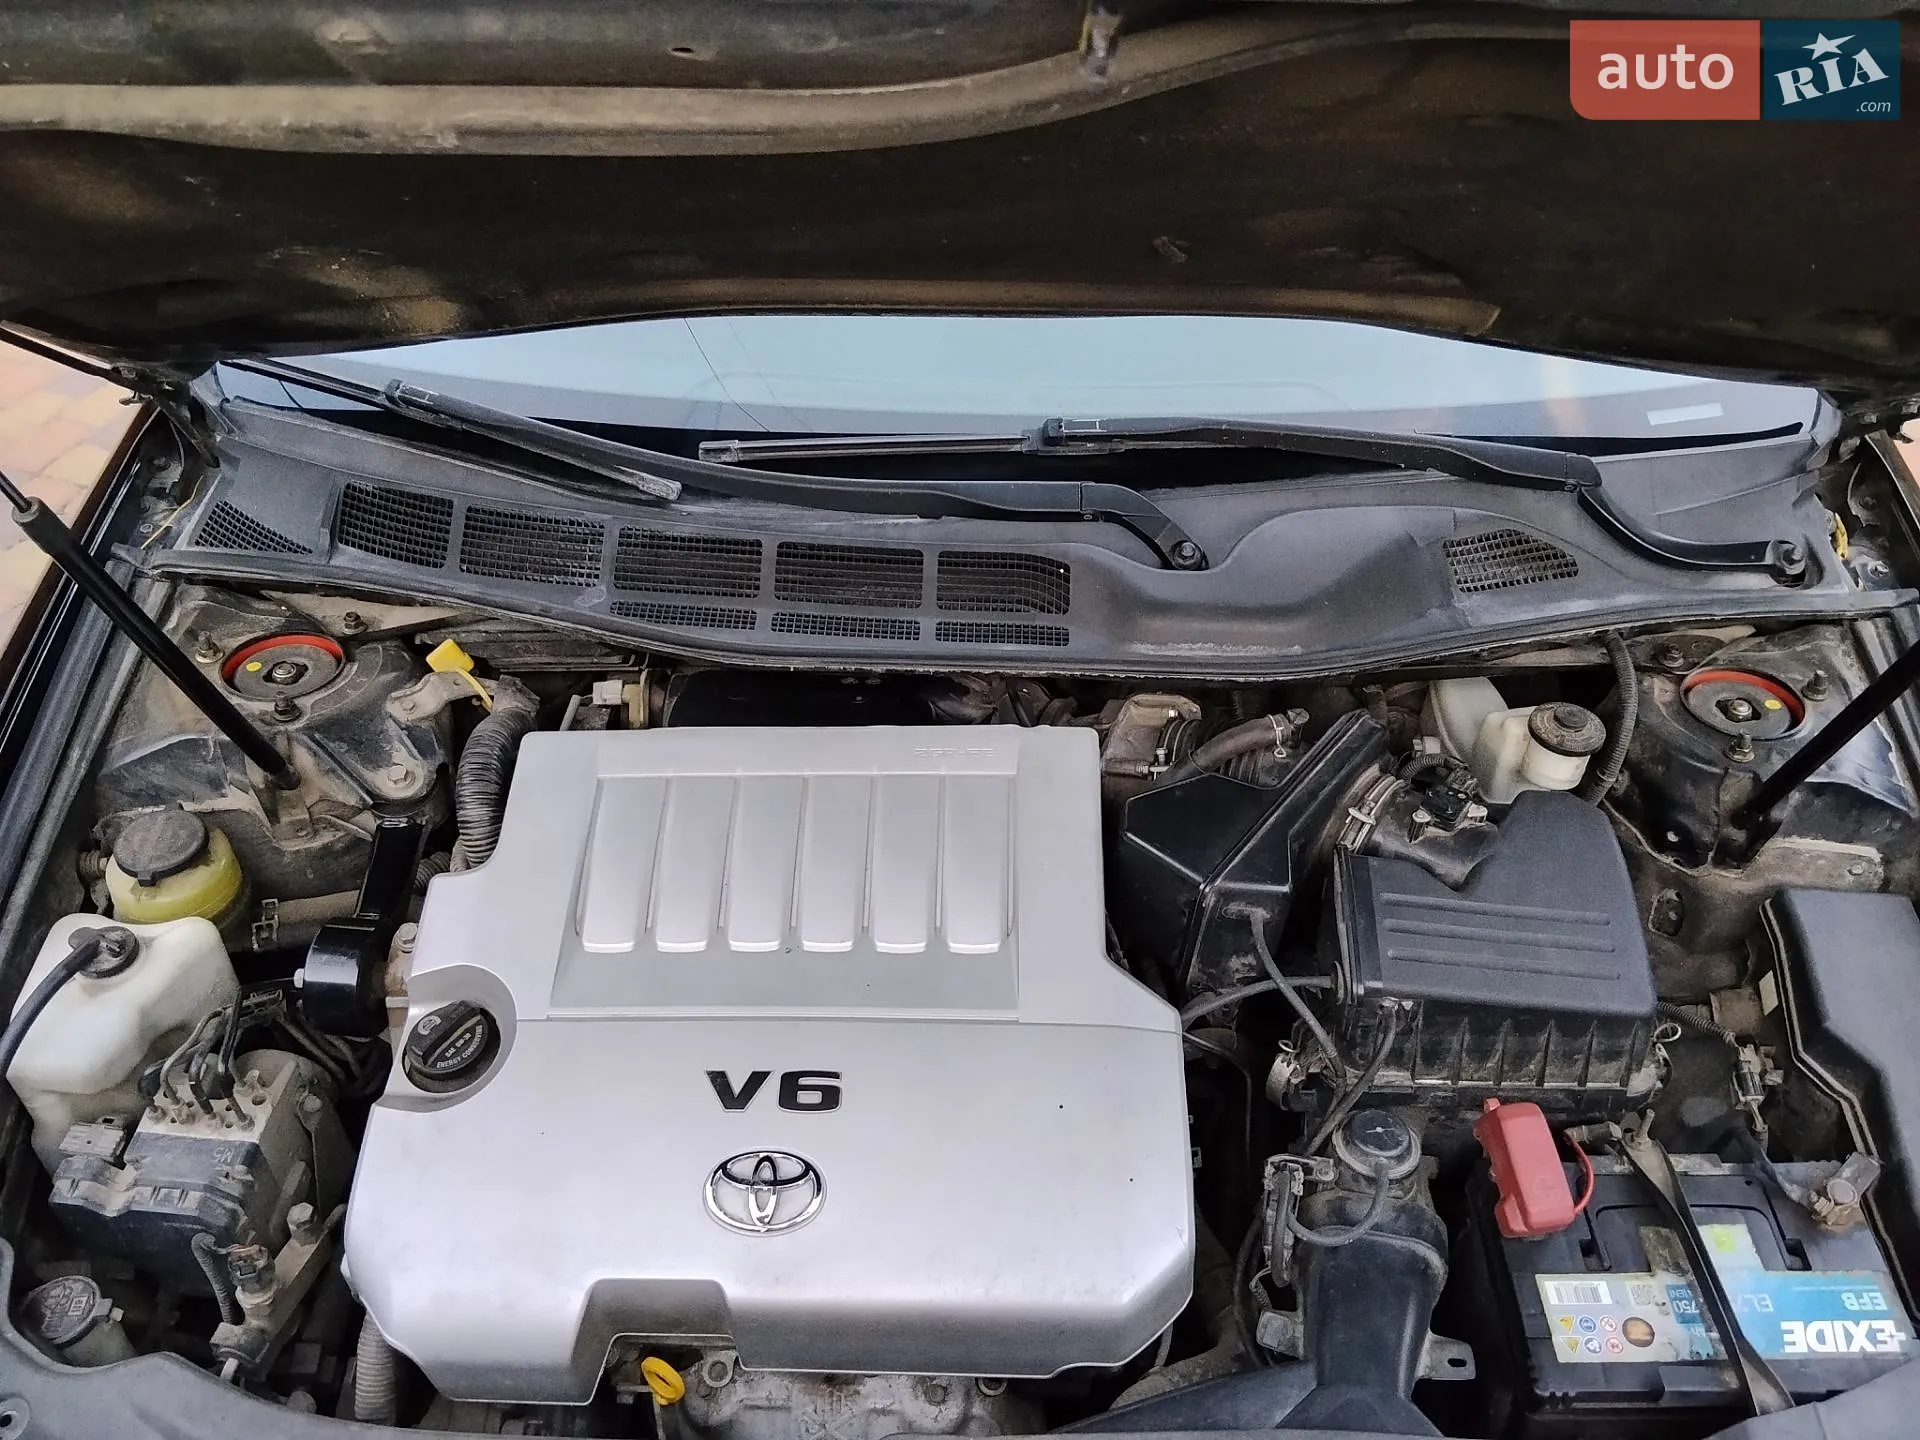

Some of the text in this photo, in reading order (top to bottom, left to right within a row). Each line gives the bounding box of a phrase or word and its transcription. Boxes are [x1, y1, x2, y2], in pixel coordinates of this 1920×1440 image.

[705, 1069, 843, 1112] V6
[1672, 1300, 1700, 1314] 750
[1840, 1292, 1888, 1311] EFB
[1780, 1320, 1906, 1353] EXIDE
